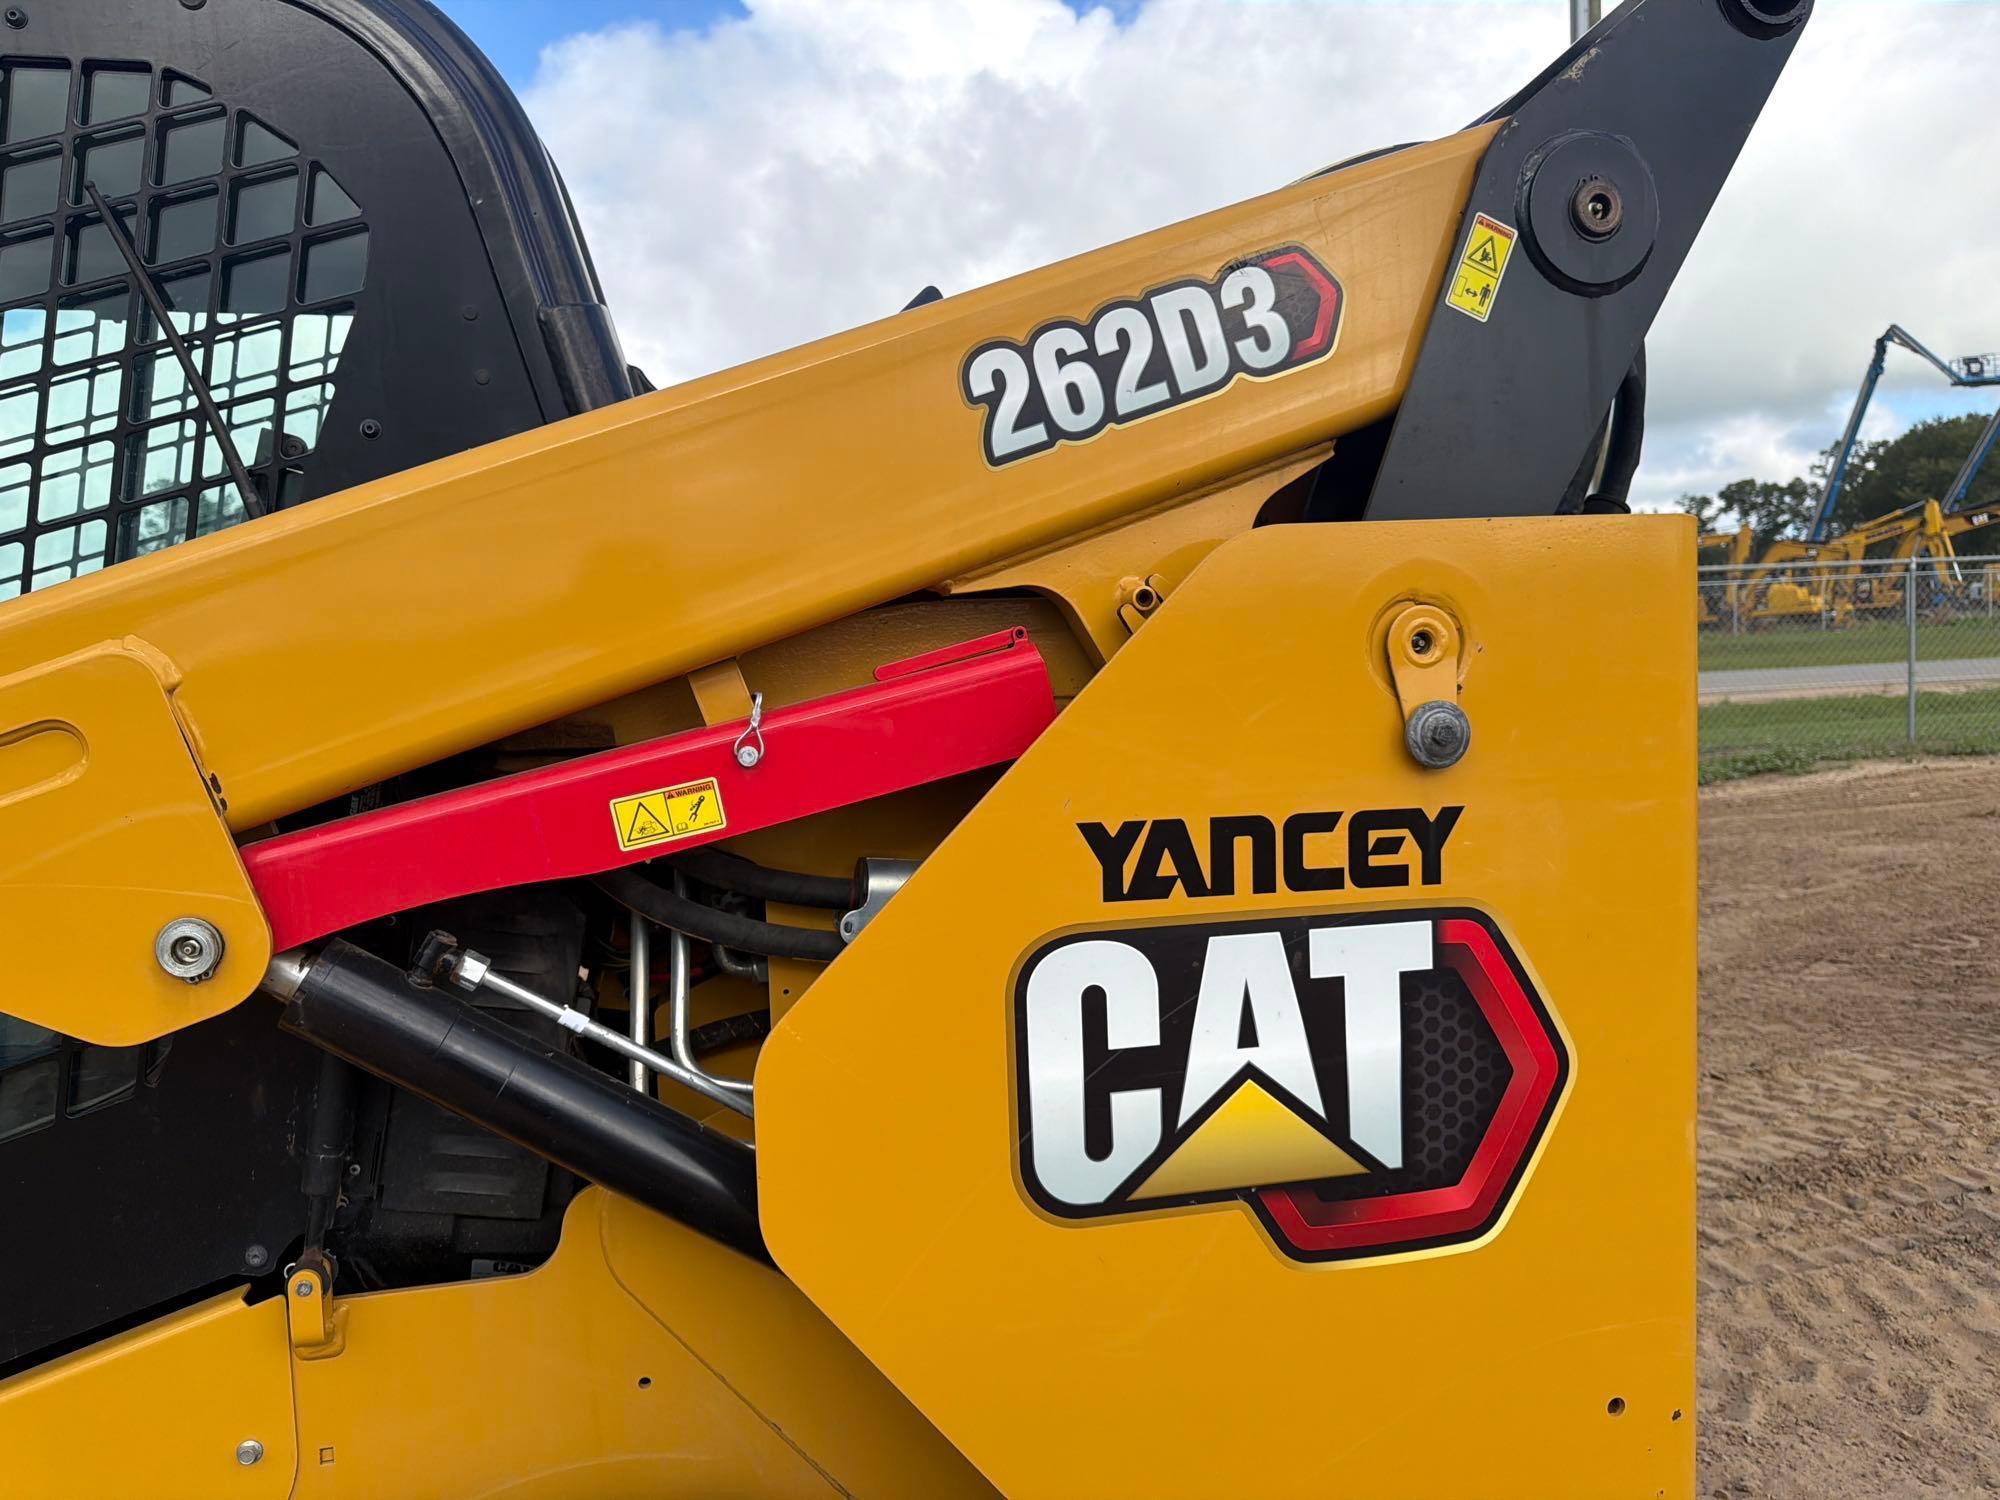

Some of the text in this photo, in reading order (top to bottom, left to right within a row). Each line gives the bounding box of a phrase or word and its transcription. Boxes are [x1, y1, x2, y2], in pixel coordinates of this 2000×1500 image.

[1486, 222, 1512, 239] WARNING
[969, 266, 1291, 457] 262D3
[675, 784, 712, 797] WARNING
[1076, 805, 1465, 902] YANCEY
[1026, 920, 1434, 1206] CAT
